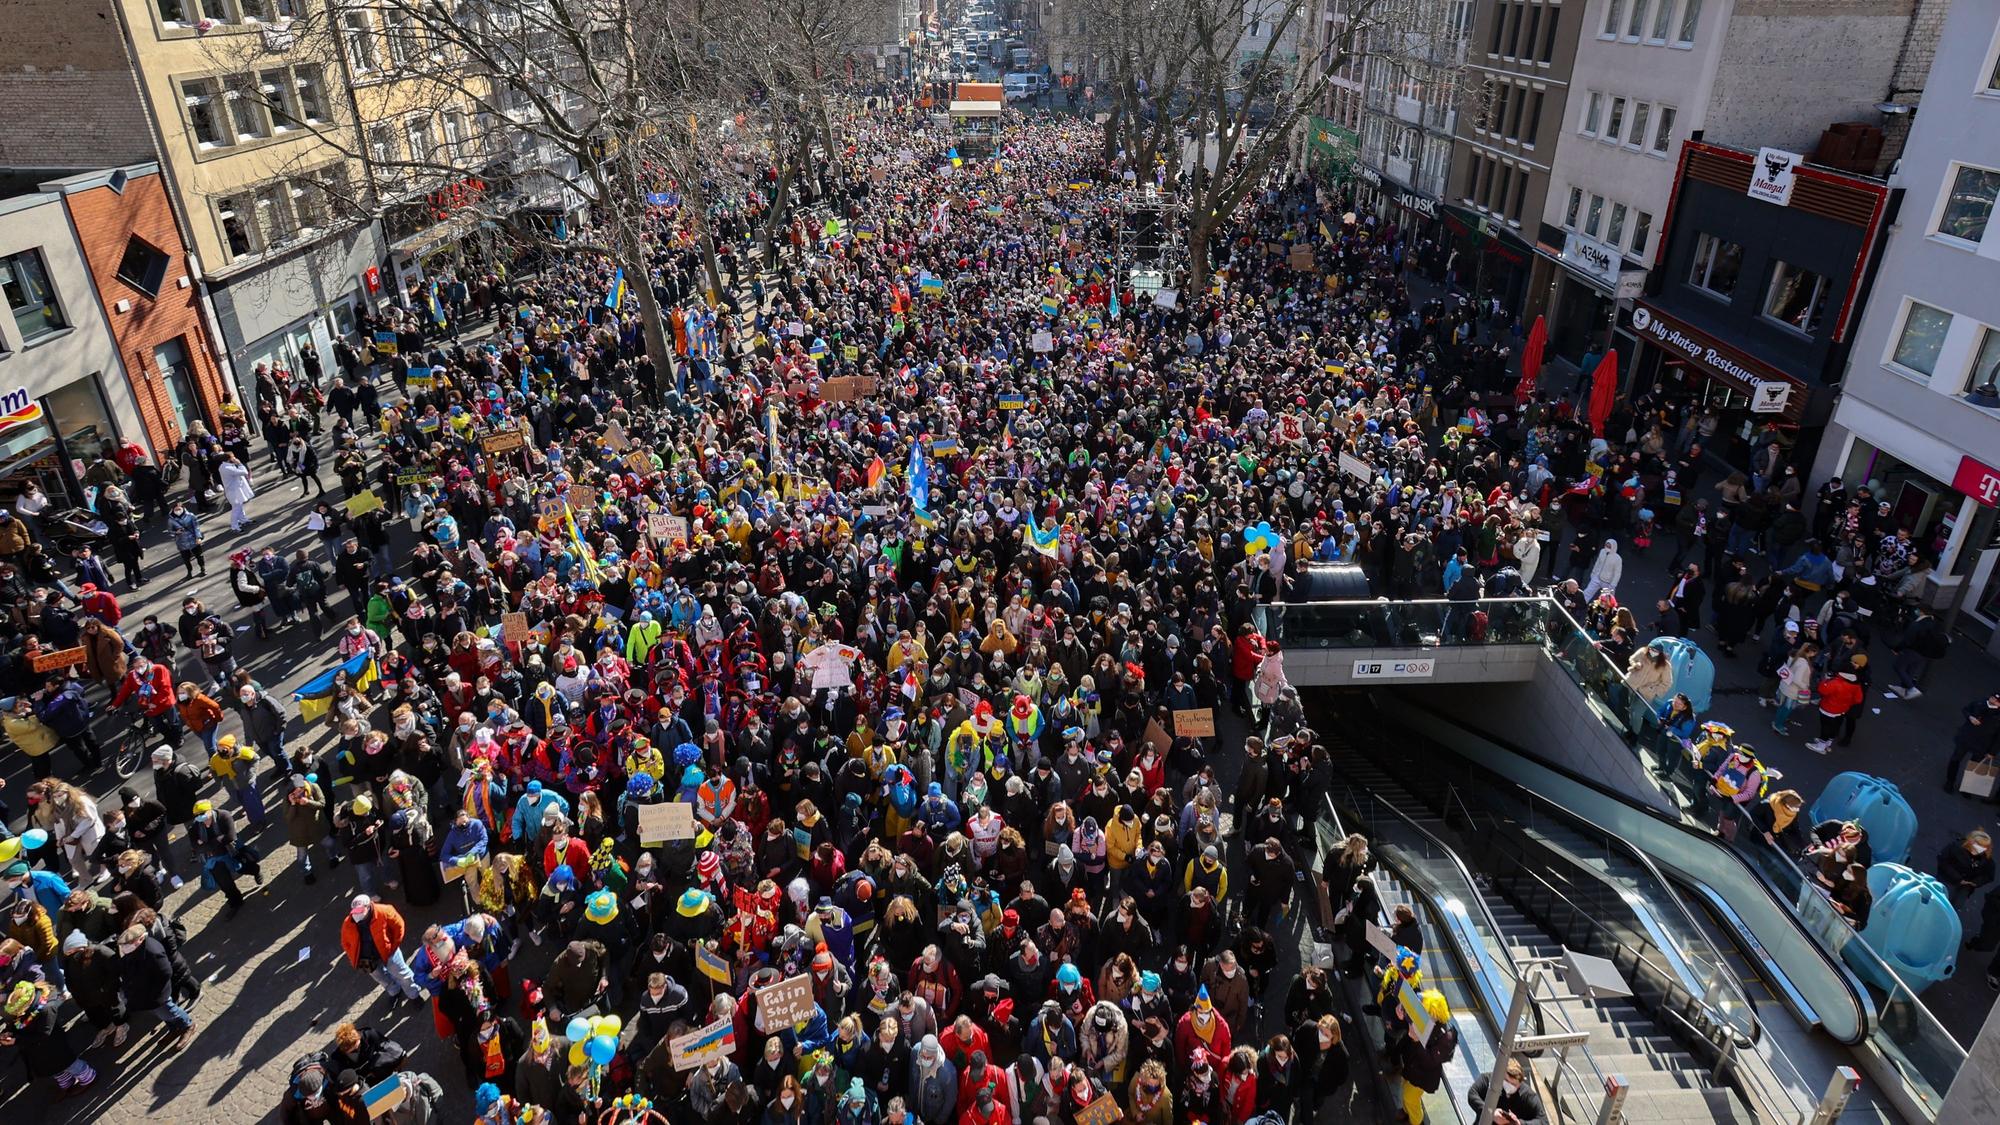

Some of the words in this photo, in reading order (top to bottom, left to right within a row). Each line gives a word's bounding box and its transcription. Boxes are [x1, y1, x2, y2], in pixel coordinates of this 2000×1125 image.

[1753, 178, 1786, 193] Mangal
[1650, 319, 1668, 340] My
[1668, 330, 1702, 357] Antep
[1704, 348, 1764, 387] Restaura
[651, 516, 677, 527] Putin
[1371, 665, 1381, 673] 17
[763, 986, 805, 1007] Putin
[704, 1017, 731, 1034] RUSSIA
[768, 1019, 790, 1031] the
